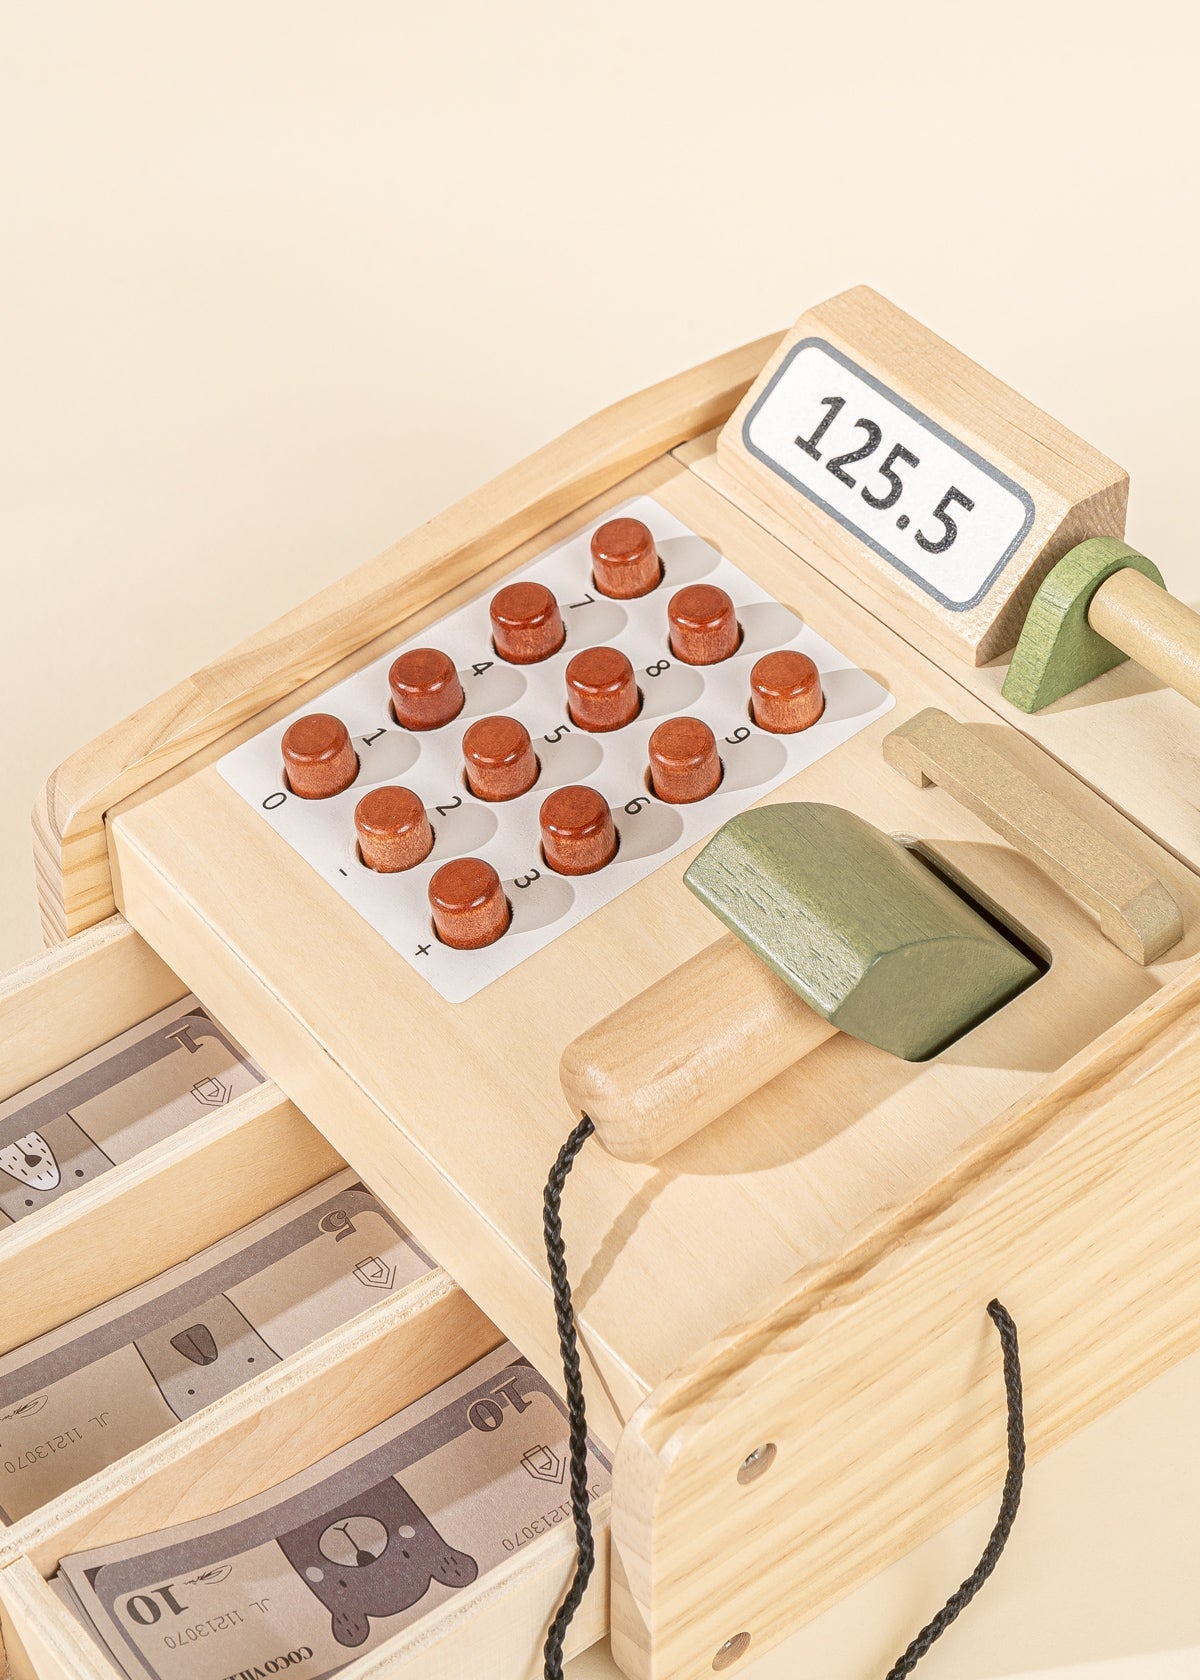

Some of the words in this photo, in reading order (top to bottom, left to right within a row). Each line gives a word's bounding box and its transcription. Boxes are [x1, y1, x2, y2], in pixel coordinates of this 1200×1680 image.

[794, 396, 975, 554] 125.5
[569, 593, 595, 609] 7
[472, 660, 494, 677] 4
[645, 659, 670, 677] 8
[362, 728, 387, 747] 1
[543, 724, 571, 744] 5
[725, 726, 751, 744] 9
[262, 791, 288, 811] 0
[436, 795, 462, 816] 2
[624, 796, 651, 815] 6
[514, 868, 541, 889] 3
[165, 1024, 203, 1054] 1
[318, 1210, 357, 1243] 5
[467, 1376, 532, 1432] 10
[88, 1411, 109, 1428] JL
[3, 1427, 83, 1474] 11213070
[126, 1584, 189, 1626] 10
[249, 1598, 270, 1614] JL
[163, 1611, 244, 1650] 11213070
[264, 1646, 313, 1674] COCO
